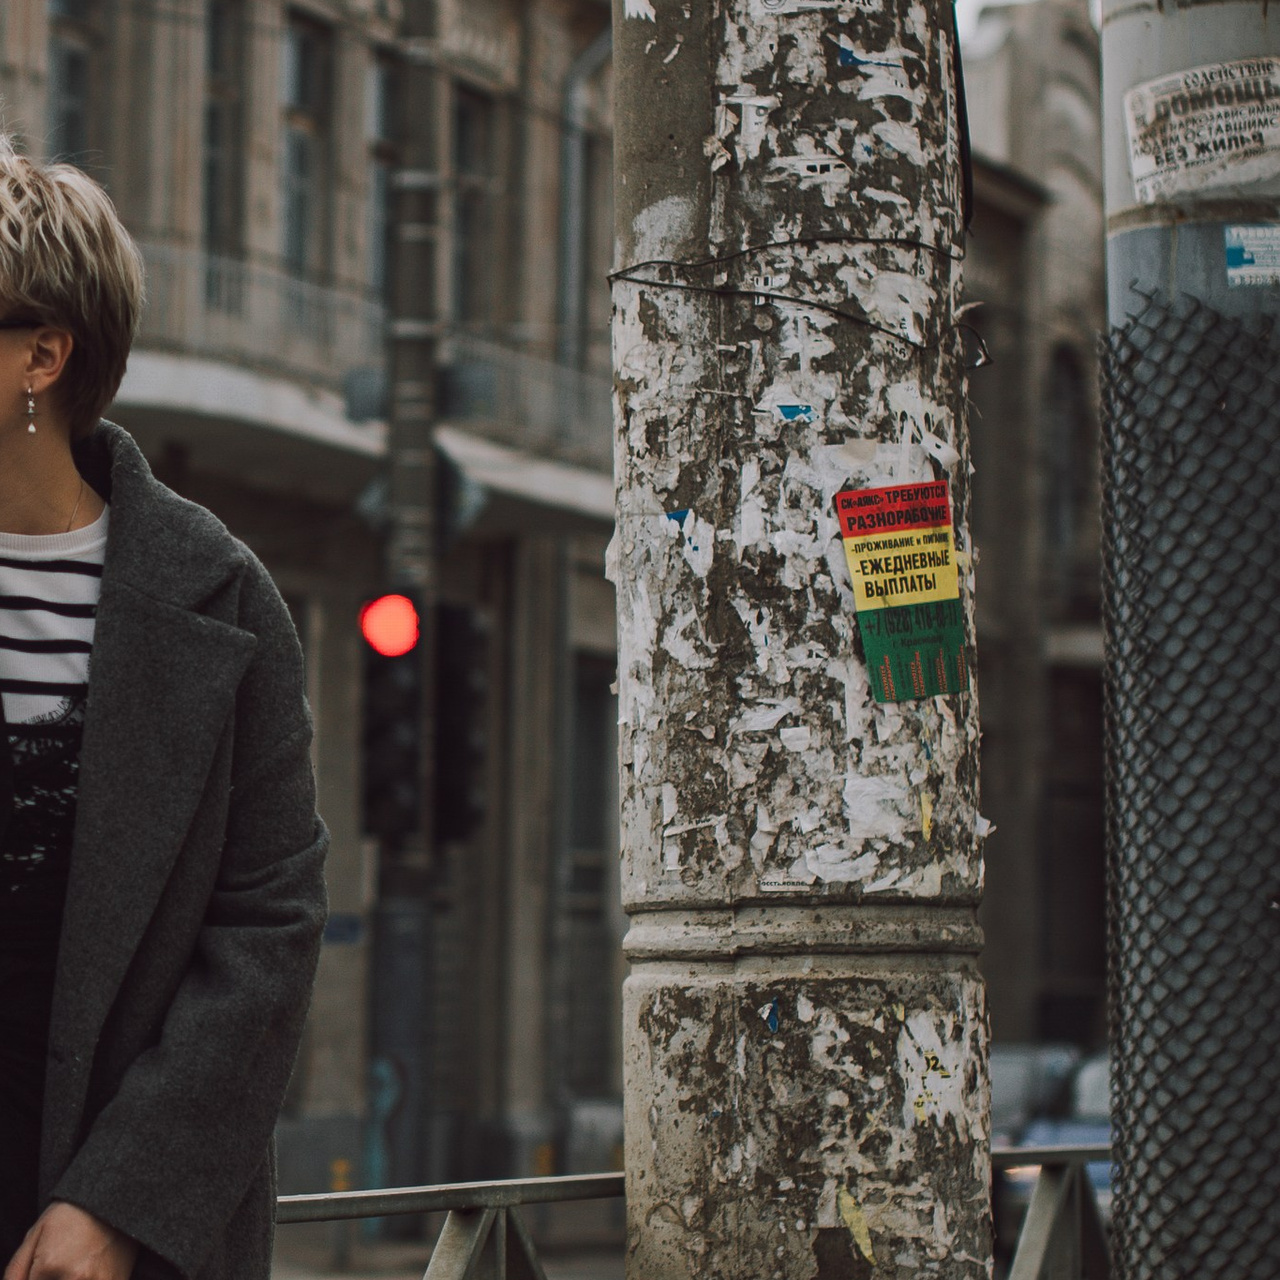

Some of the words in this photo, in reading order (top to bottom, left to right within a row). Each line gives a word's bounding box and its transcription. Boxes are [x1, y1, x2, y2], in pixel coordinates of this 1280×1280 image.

[1154, 145, 1188, 167] БЕЗ
[1194, 131, 1264, 156] ЖИЛЬЯ
[885, 485, 946, 504] ТРЕБУЮТСЯ
[847, 505, 948, 531] РАЗНОРАБОЧИЕ
[865, 573, 937, 598] ВЫПЛАТЫ
[865, 611, 881, 636] +7
